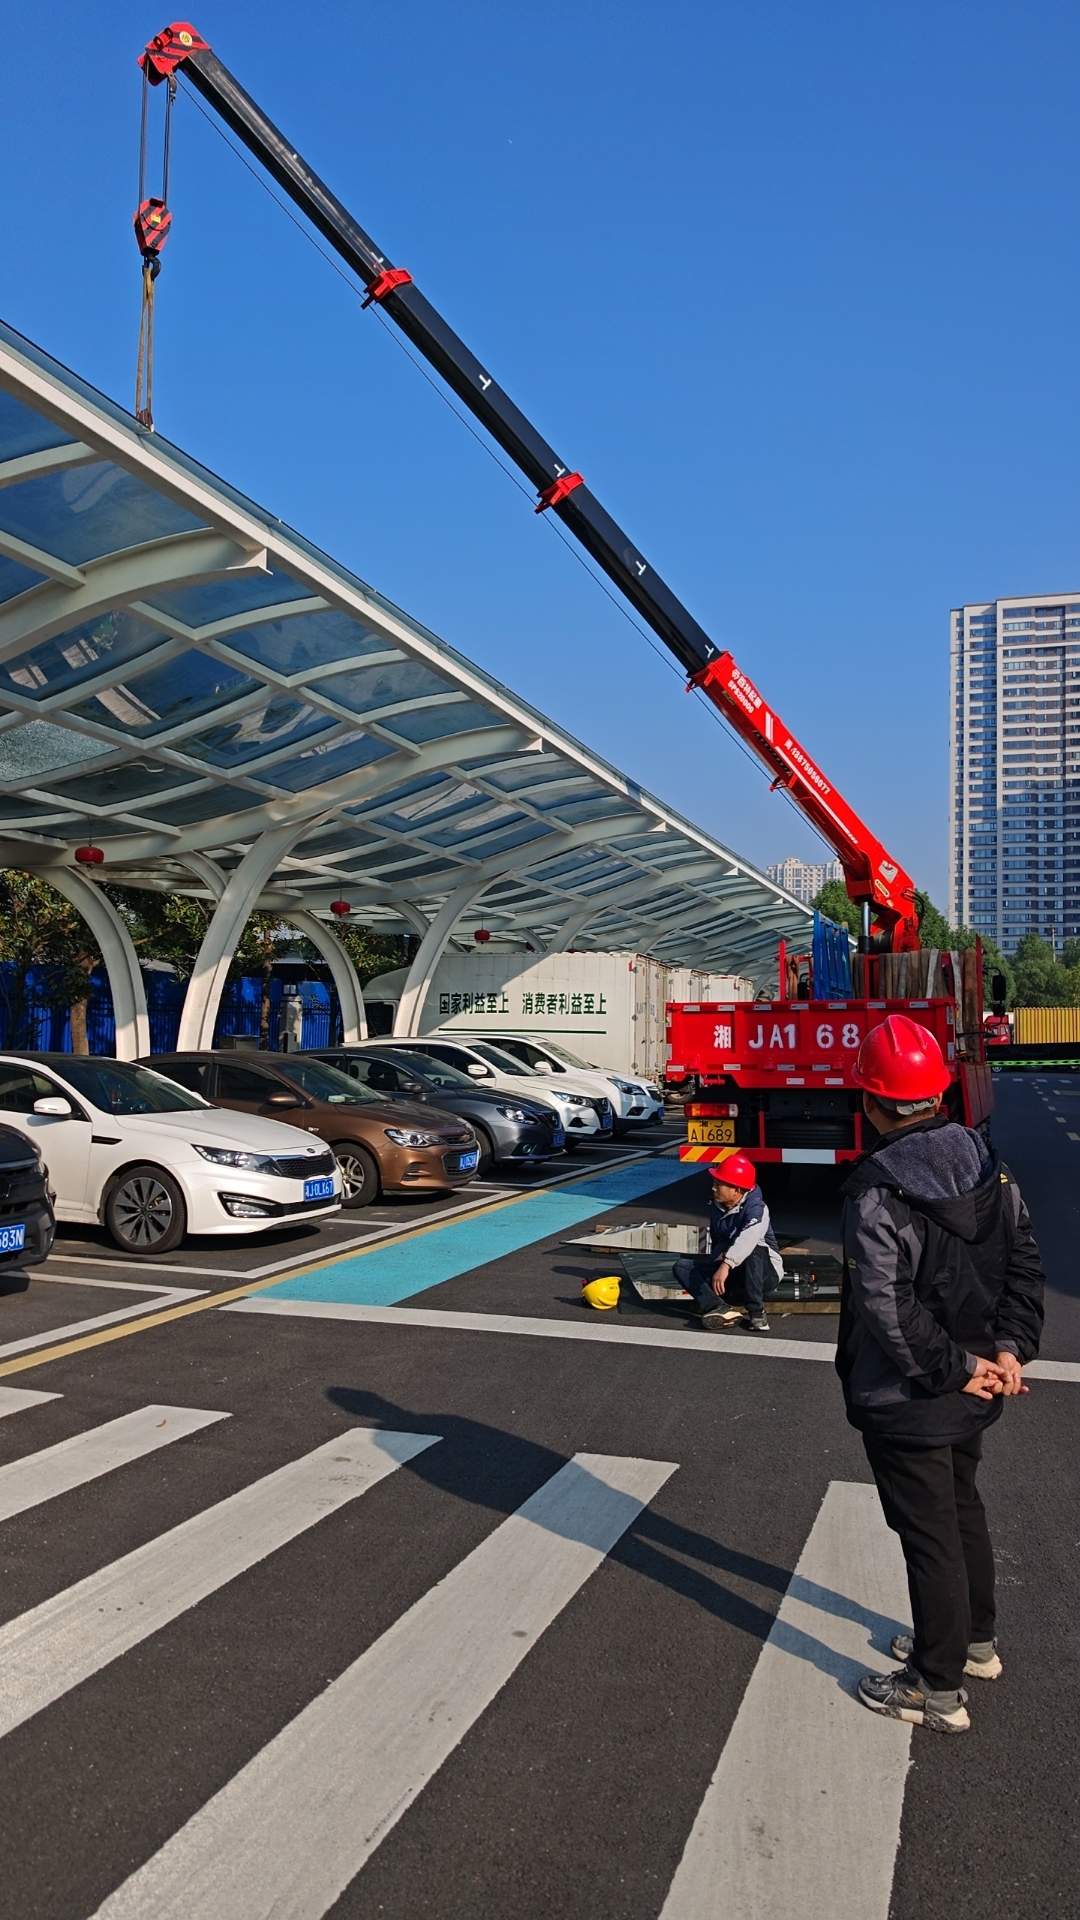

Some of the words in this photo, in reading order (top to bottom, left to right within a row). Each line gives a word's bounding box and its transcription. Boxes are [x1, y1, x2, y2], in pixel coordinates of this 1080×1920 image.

[439, 992, 509, 1015] 国家利益至上
[522, 992, 607, 1015] 消费者利益至上
[690, 1128, 733, 1142] A1689
